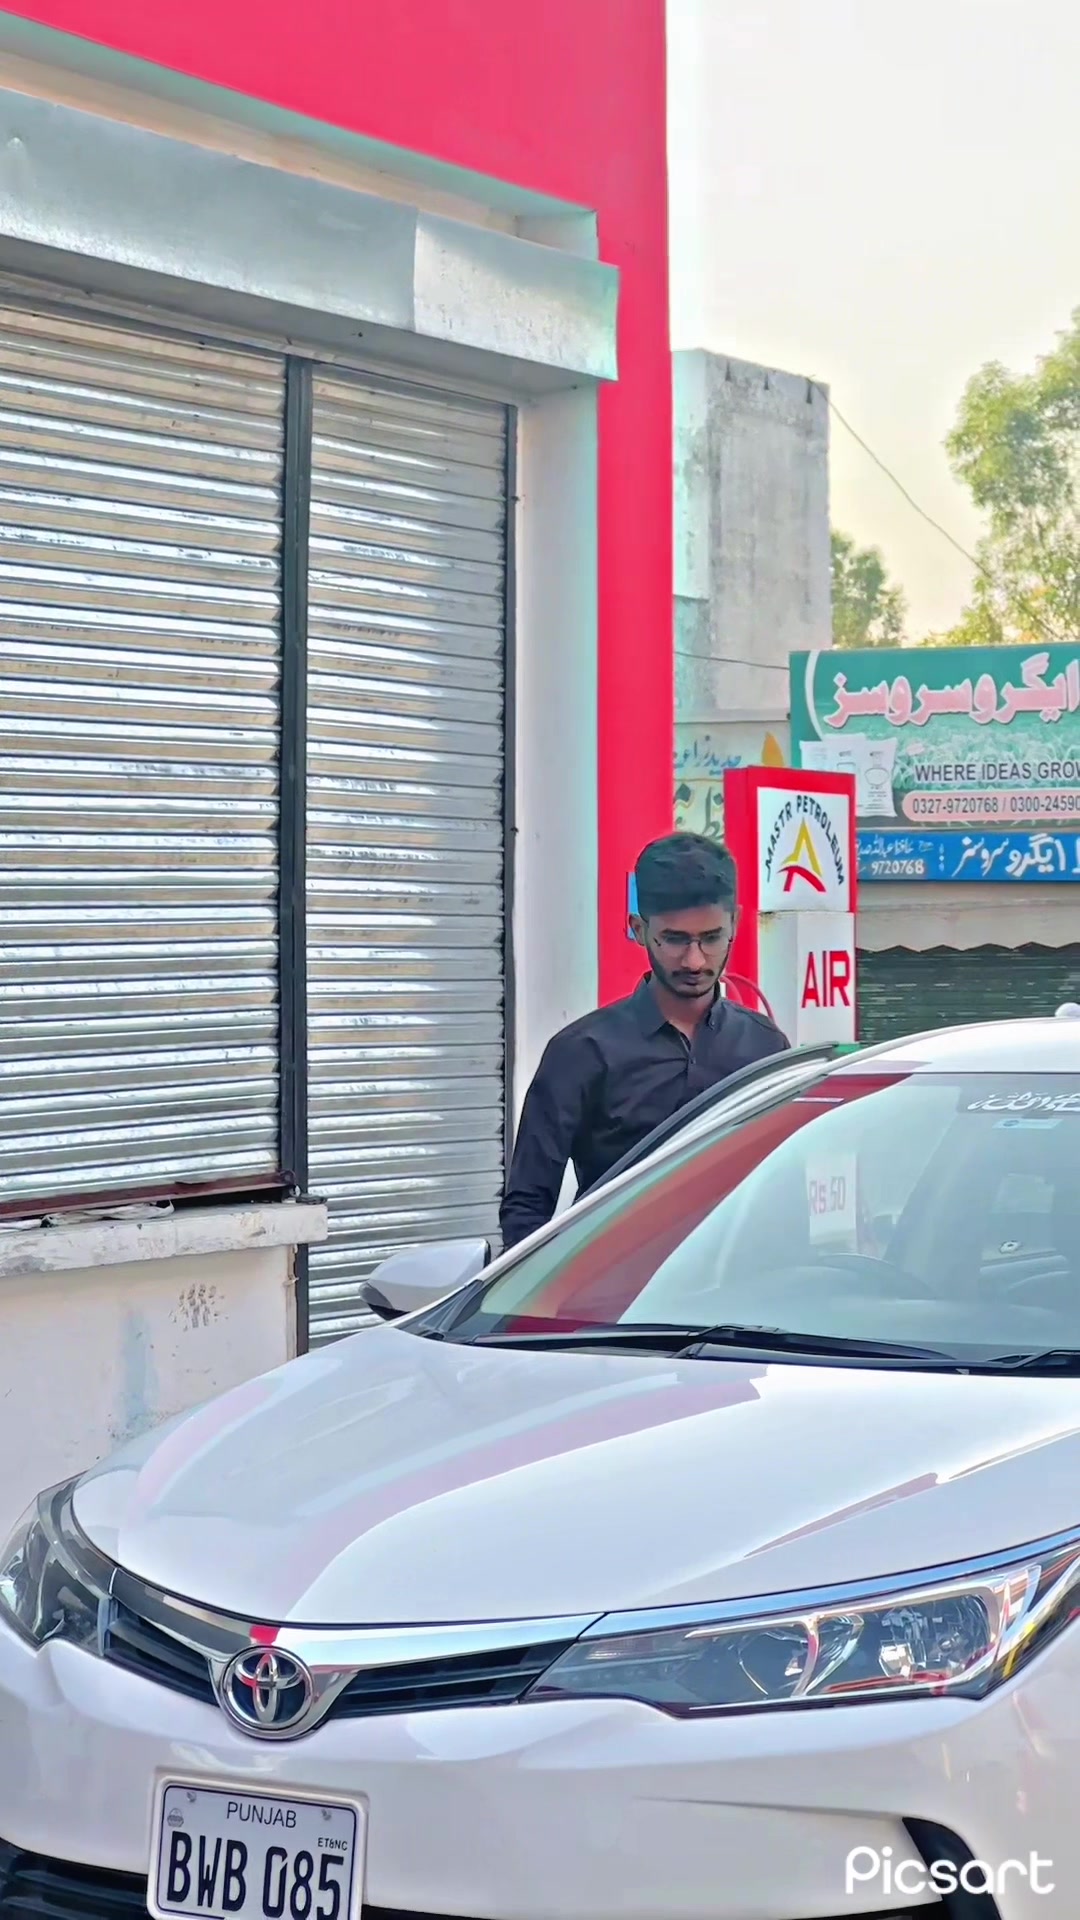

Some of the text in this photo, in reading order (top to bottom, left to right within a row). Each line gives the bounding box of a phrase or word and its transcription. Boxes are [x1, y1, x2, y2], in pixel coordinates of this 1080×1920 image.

[914, 763, 977, 782] WHERE
[982, 761, 1032, 780] IDEAS
[912, 797, 999, 814] 0327-9720768
[765, 801, 793, 883] MASTR
[796, 794, 845, 886] PETROLEUM
[801, 950, 851, 1008] AIR
[226, 1801, 297, 1829] PUNJAB
[317, 1837, 348, 1851] ET&NC
[167, 1830, 345, 1920] BWB 085
